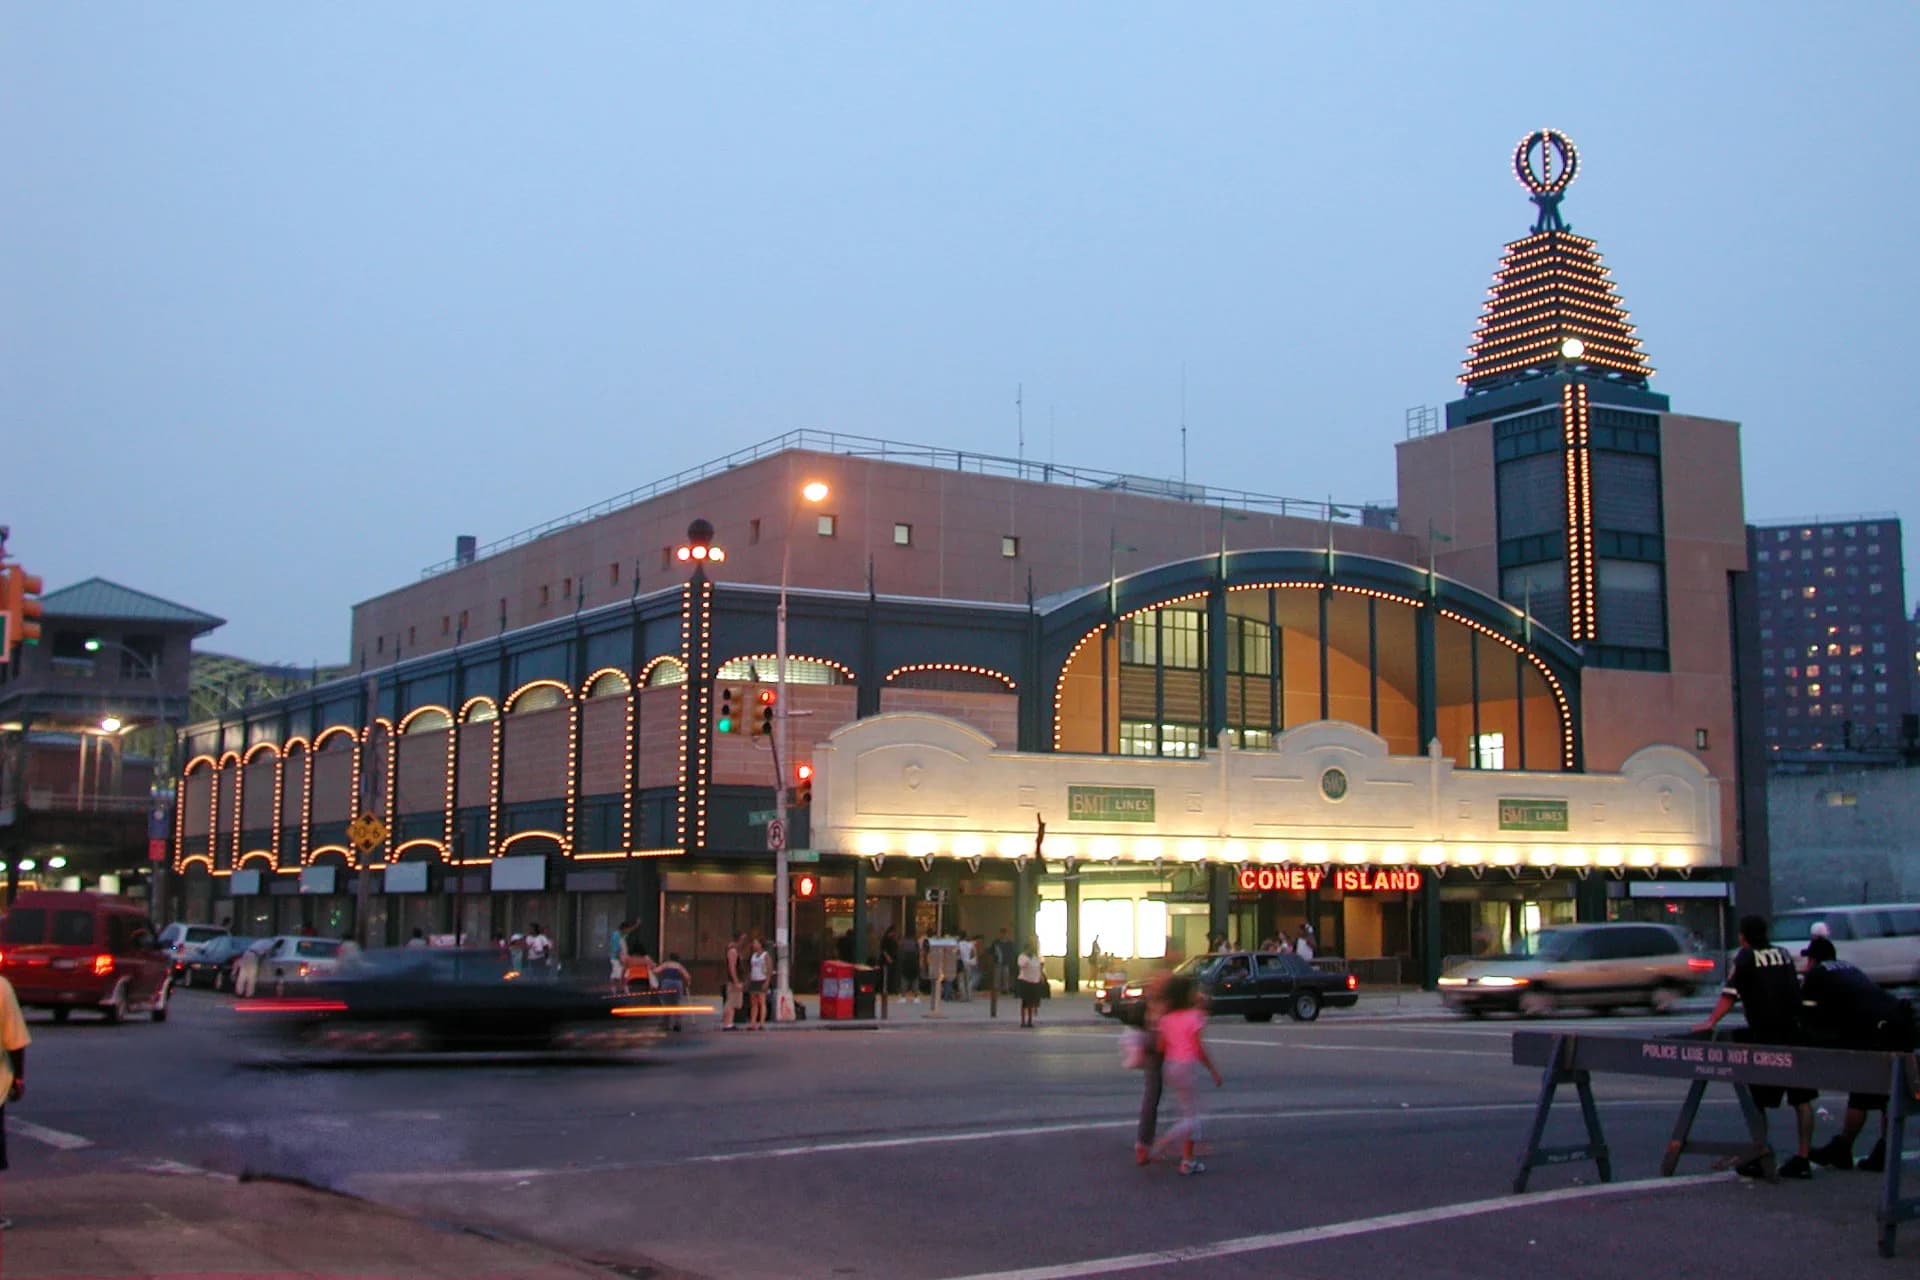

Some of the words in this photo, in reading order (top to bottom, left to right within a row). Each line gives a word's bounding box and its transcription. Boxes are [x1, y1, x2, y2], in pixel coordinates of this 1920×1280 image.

[1115, 799, 1149, 811] LINES
[1240, 870, 1321, 890] CONEY
[1336, 871, 1421, 891] ISLAND
[1643, 1044, 1678, 1059] POLICE
[1681, 1047, 1704, 1062] LINE
[1708, 1049, 1723, 1063] DO
[1727, 1050, 1748, 1064] NOT
[1753, 1051, 1793, 1067] CROSS
